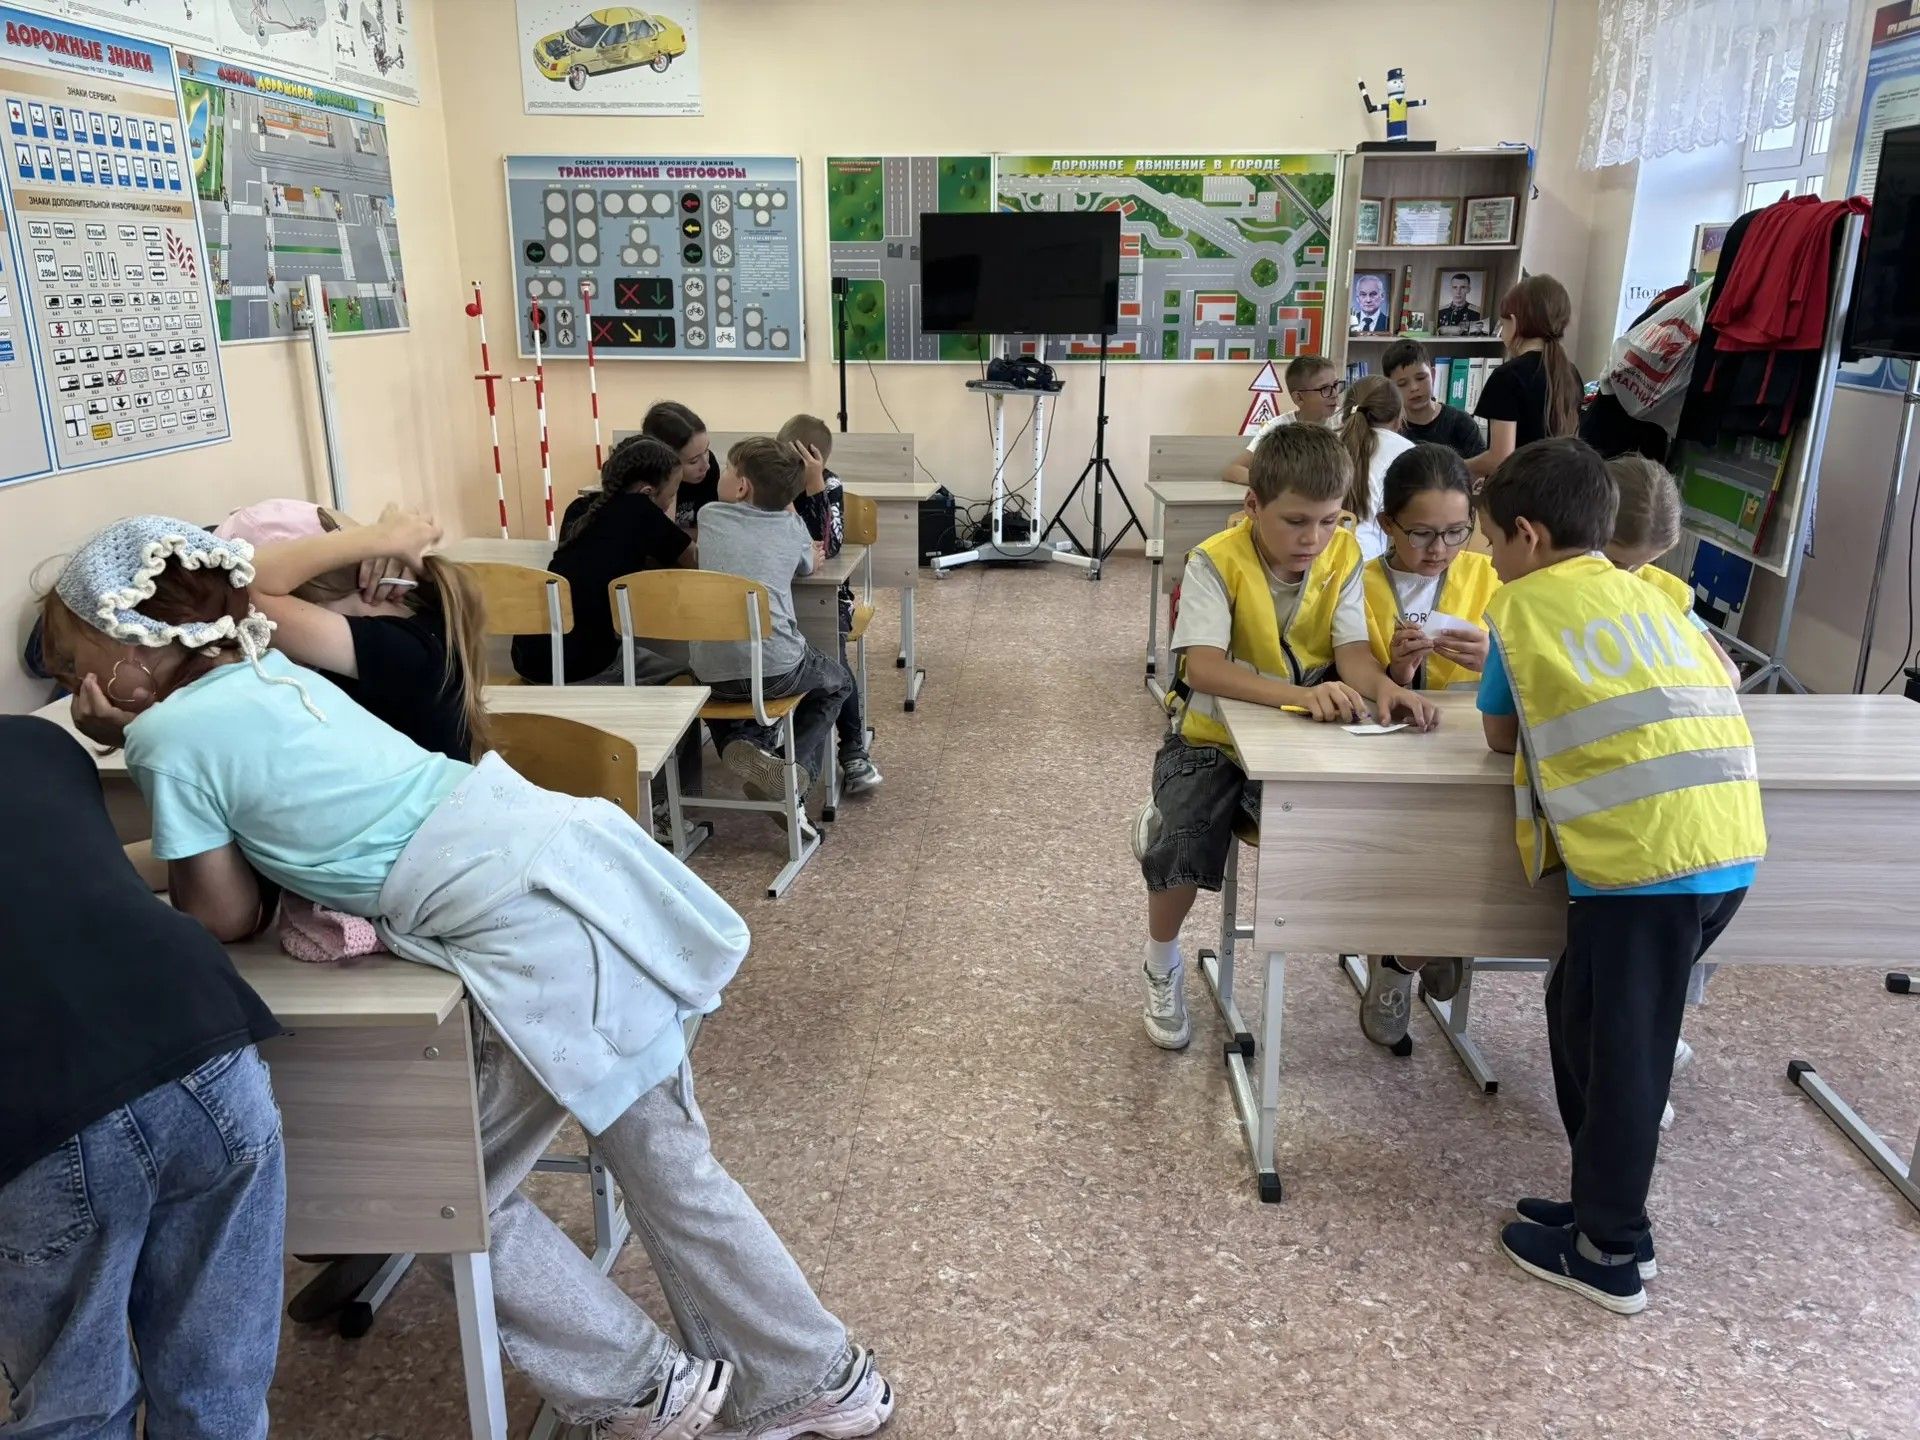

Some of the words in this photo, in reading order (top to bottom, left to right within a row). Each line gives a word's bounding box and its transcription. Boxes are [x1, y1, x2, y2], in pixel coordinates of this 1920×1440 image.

[6, 20, 103, 62] ДОРОЖНЫЕ
[107, 44, 154, 73] ЗНАКИ
[66, 86, 87, 98] ЗНАКИ
[88, 90, 118, 103] СЕРВИСА
[1052, 159, 1124, 171] ДОРОЖНОЕ
[1134, 159, 1206, 171] ДВИЖЕНИЕ
[1214, 159, 1222, 171] В
[1230, 159, 1281, 171] ГОРОДЕ
[558, 167, 660, 178] ТРАНСПОРТНЫЕ
[666, 167, 747, 178] СВЕТОФОРЫ
[28, 196, 50, 206] ЗНАКИ
[52, 198, 111, 209] ДОПОЛНИТЕЛЬНОЙ
[111, 202, 150, 212] ИНФОРМАЦИИ
[151, 204, 183, 215] (ТАБЛИЧКИ)
[37, 254, 54, 263] STOP
[41, 269, 56, 277] 250м
